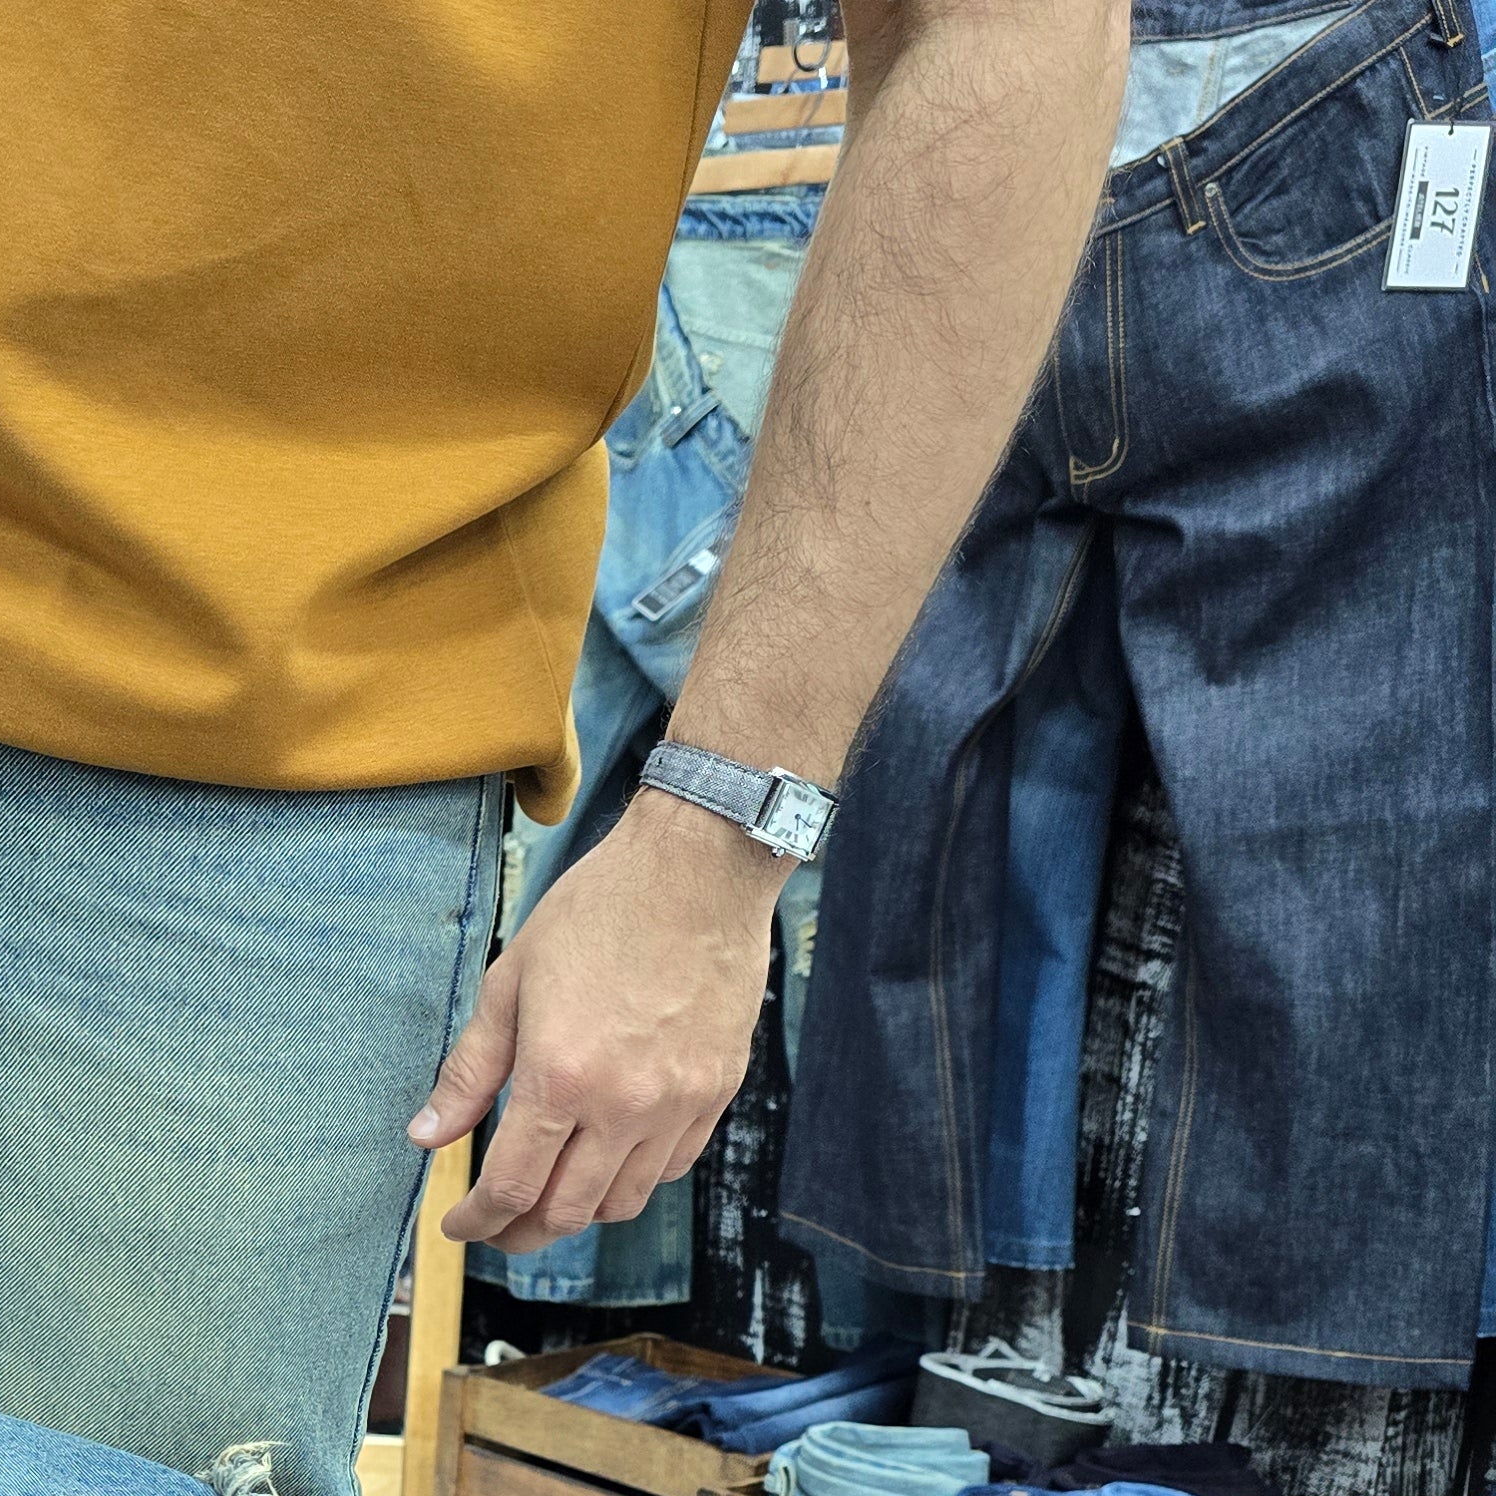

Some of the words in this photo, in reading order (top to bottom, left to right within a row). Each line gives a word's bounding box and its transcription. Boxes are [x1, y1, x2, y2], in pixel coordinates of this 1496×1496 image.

[1430, 188, 1460, 235] 127
[1463, 163, 1477, 213] PERFECTLY
[1455, 216, 1469, 258] CRAFTED
